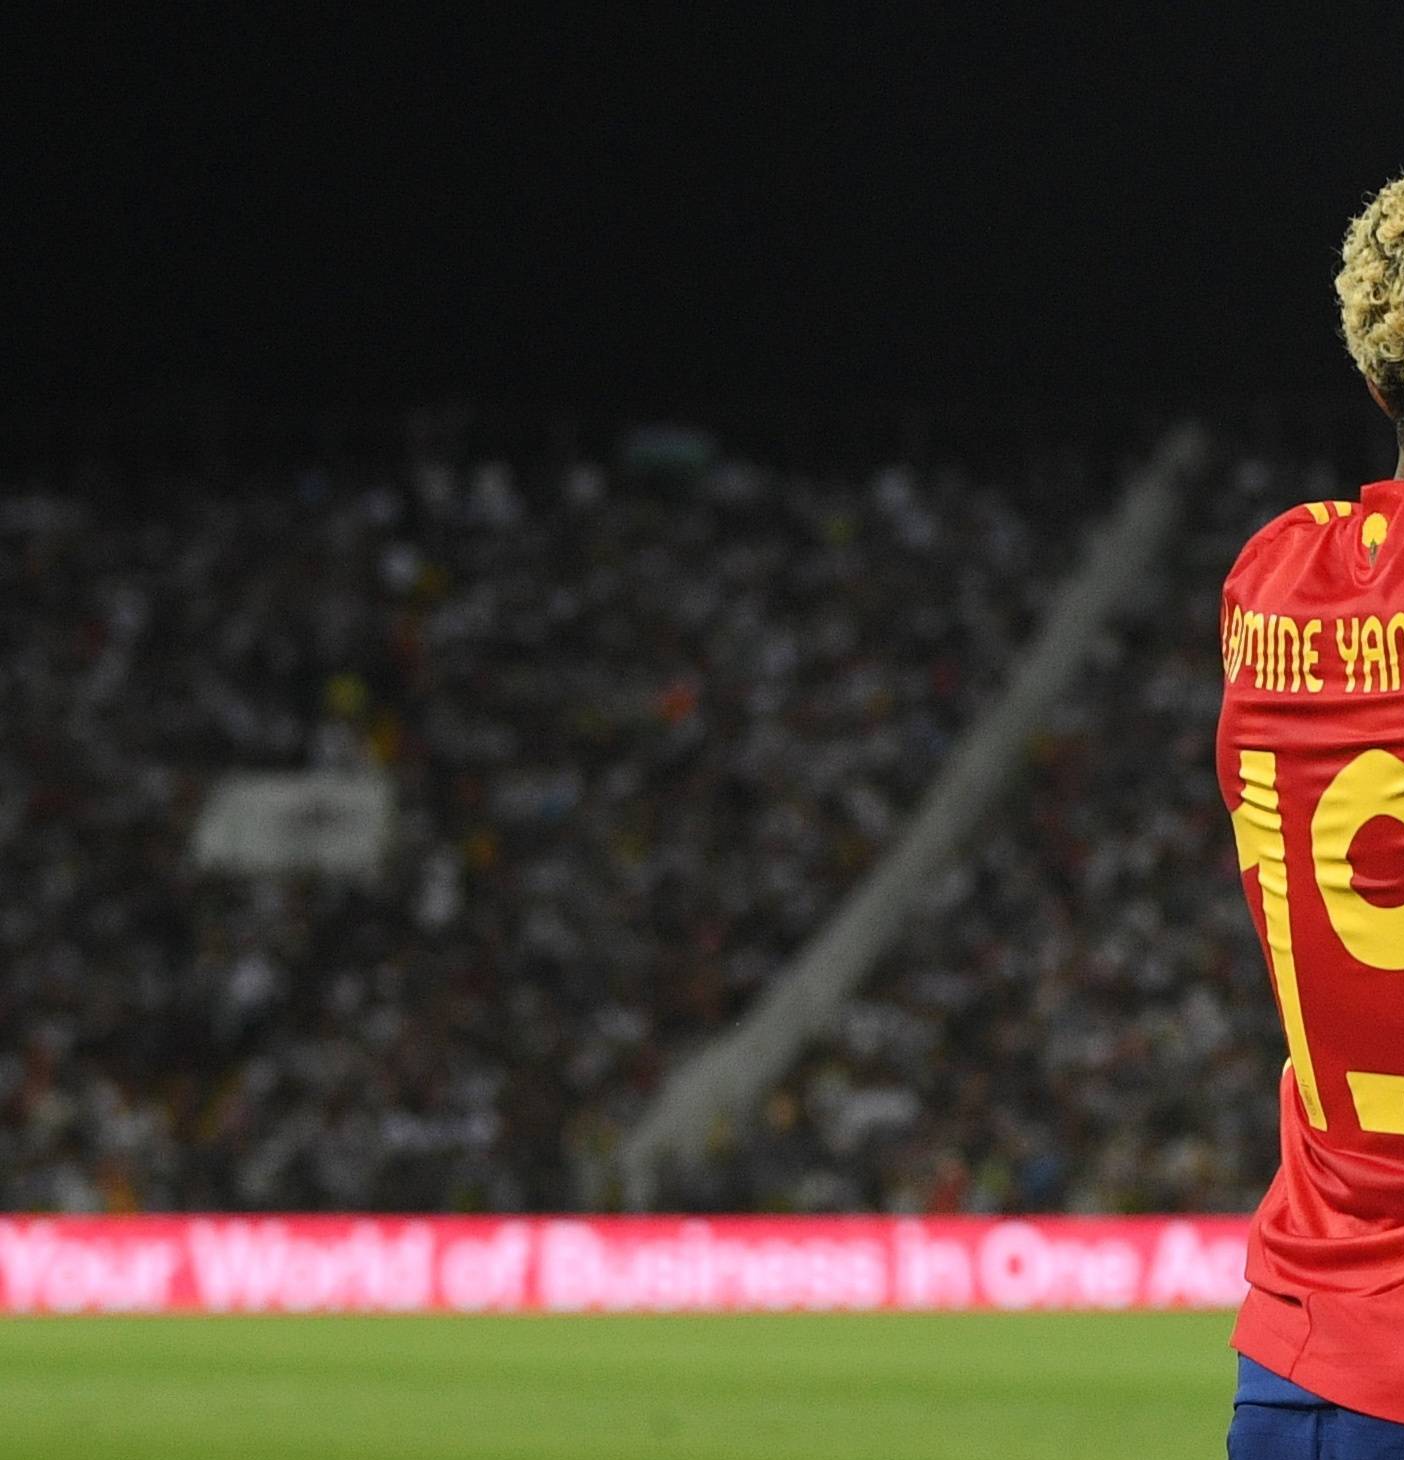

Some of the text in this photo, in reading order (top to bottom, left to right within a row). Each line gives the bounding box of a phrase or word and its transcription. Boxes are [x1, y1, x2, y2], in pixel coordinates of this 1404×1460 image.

[0, 1220, 170, 1312] Your
[186, 1220, 433, 1312] World
[440, 1220, 532, 1312] of
[536, 1220, 886, 1312] Business
[893, 1220, 970, 1312] in
[978, 1220, 1138, 1312] One
